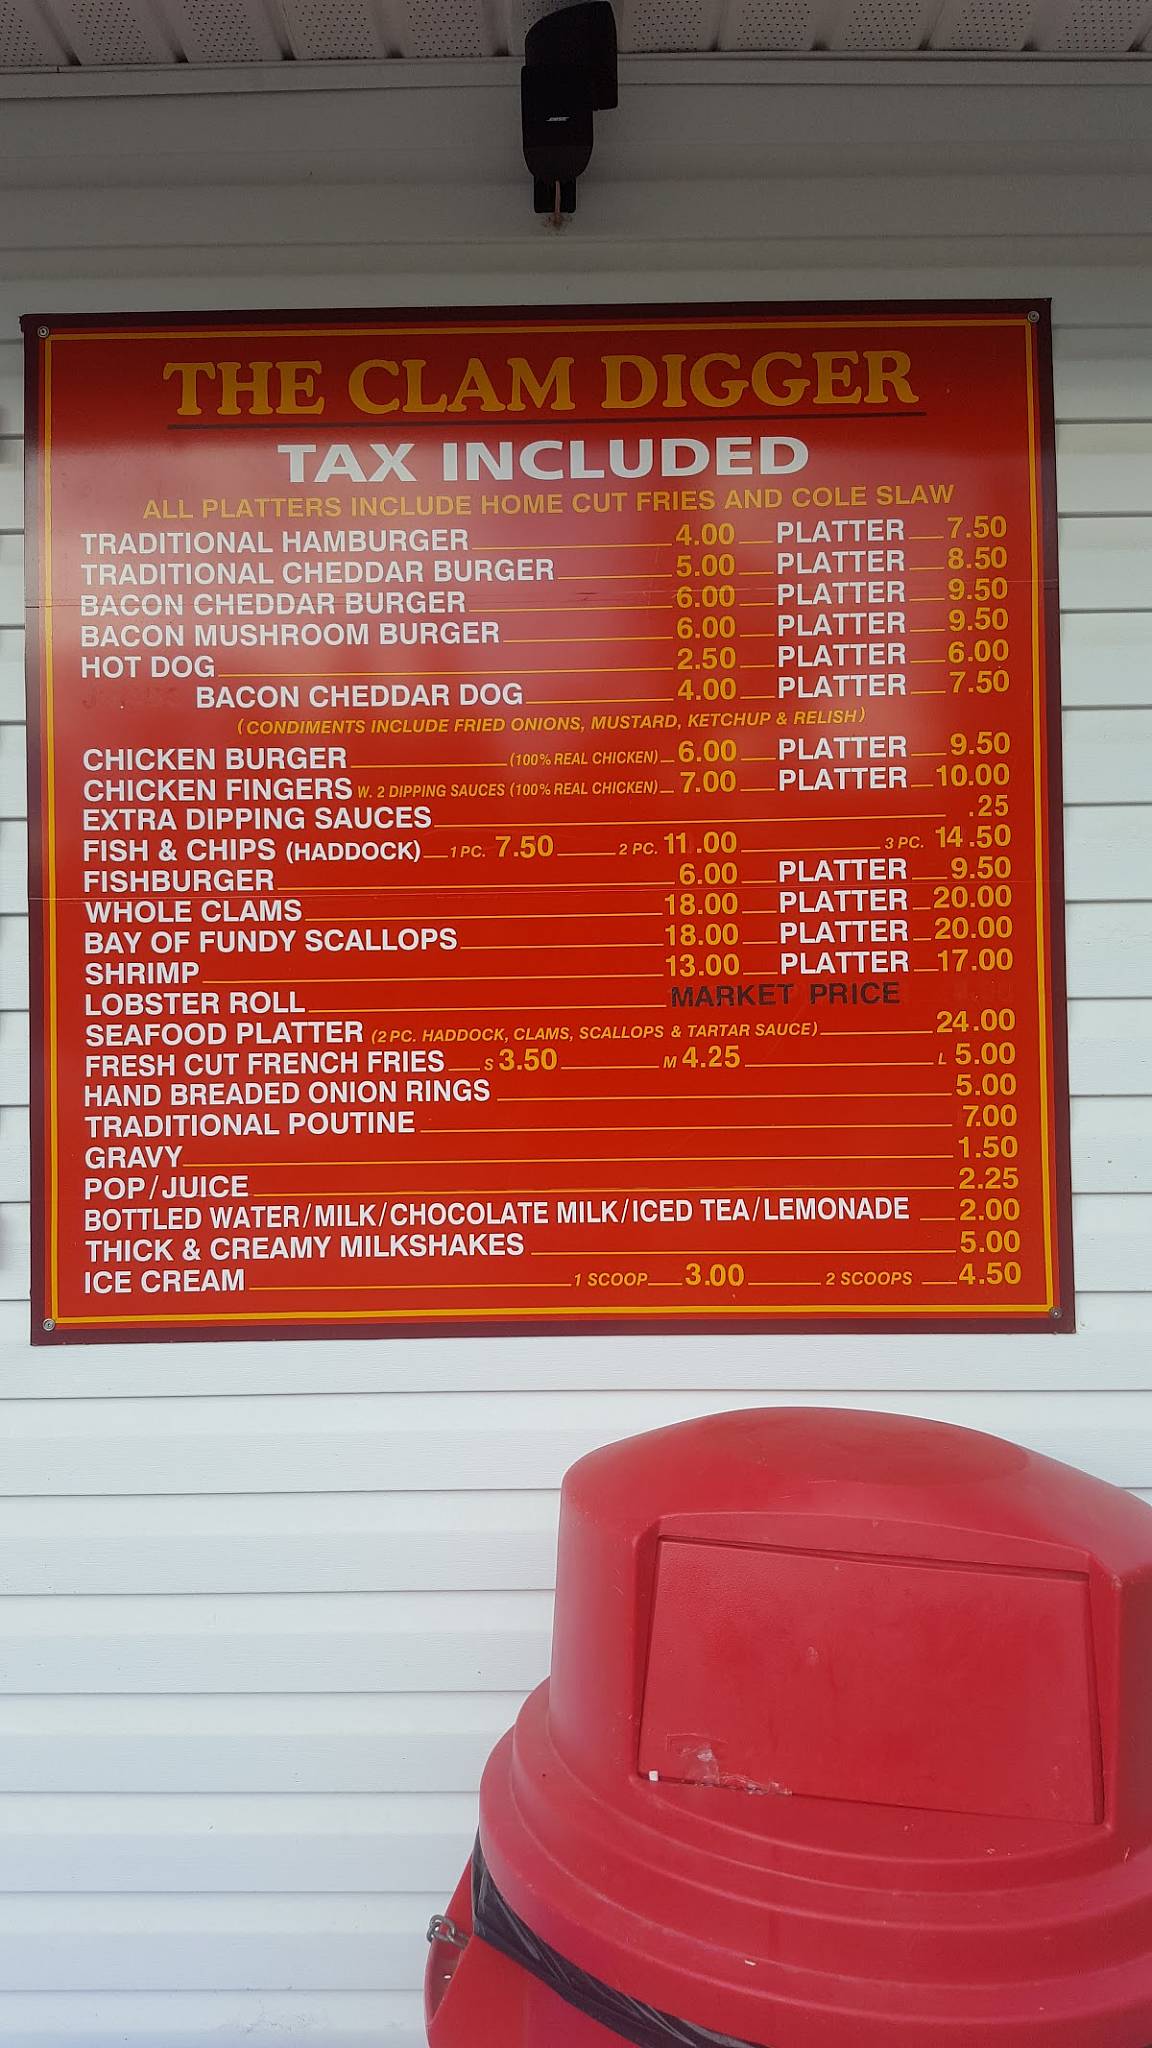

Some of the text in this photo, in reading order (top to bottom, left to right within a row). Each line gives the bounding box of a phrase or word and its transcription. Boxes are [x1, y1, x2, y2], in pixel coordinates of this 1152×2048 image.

[163, 351, 919, 415] THE CLAM DIGGER
[278, 437, 808, 482] TAX INCLUDED
[143, 485, 953, 519] ALL PLATTERS INCLUDE HOME CUT FRIES AND COLE SLAW
[676, 522, 734, 545] 4.00
[778, 519, 904, 543] PLATTER
[947, 516, 1006, 539] 7.50
[81, 529, 468, 554] TRADITIONAL HAMBURGER
[677, 554, 734, 577] 5.00
[778, 550, 904, 574] PLATTER
[948, 546, 1007, 569] 8.50
[81, 559, 553, 585] TRADITIONAL CHEDDAR BURGER
[676, 584, 735, 608] 6.00
[778, 581, 905, 605] PLATTER
[948, 577, 1007, 601] 9.50
[81, 591, 466, 616] BACON CHEDDAR BURGER
[677, 616, 735, 639] 6.00
[779, 612, 905, 636] PLATTER
[949, 607, 1008, 631] 9.50
[81, 622, 499, 647] BACON MUSHROOM BURGER
[678, 647, 735, 669] 2.50
[779, 643, 905, 667] PLATTER
[949, 639, 1008, 663] 6.00
[82, 656, 214, 678] HOT DOG
[678, 678, 736, 700] 4.00
[779, 674, 905, 698] PLATTER
[950, 670, 1009, 693] 7.50
[197, 683, 522, 708] BACON CHEDDAR DOG
[238, 707, 865, 734] (CONDIMENTS INCLUDE FRIED ONIONS, MUSTARD, KETCHUP & RELISH)
[679, 740, 736, 762] 6.00
[780, 736, 906, 760] PLATTER
[951, 732, 1010, 755] 9.50
[83, 747, 346, 771] CHICKEN BURGER
[510, 750, 658, 767] (100% REAL CHICKEN)
[681, 770, 736, 793] 7.00
[780, 767, 906, 791] PLATTER
[936, 763, 1009, 786] 10.00
[84, 778, 352, 801] CHICKEN FINGERS
[84, 806, 431, 830] EXTRA DIPPING SAUCES
[968, 795, 1009, 818] .25
[496, 835, 553, 858] 7.50
[664, 832, 736, 854] 11.00
[936, 824, 1011, 848] 14.50
[84, 838, 420, 863] FISH & CHIPS (HADDOCK)
[680, 863, 737, 885] 6.00
[780, 858, 906, 882] PLATTER
[951, 856, 1011, 879] 9.50
[84, 869, 273, 892] FISHBURGER
[665, 893, 737, 915] 18.00
[780, 889, 907, 913] PLATTER
[934, 885, 1011, 908] 20.00
[85, 899, 301, 923] WHOLE CLAMS
[665, 923, 738, 945] 18.00
[781, 920, 908, 943] PLATTER
[935, 916, 1012, 939] 20.00
[85, 928, 457, 953] BAY OF FUNDY SCALLOPS
[666, 954, 739, 977] 13.00
[782, 951, 908, 974] PLATTER
[938, 948, 1013, 971] 17.00
[86, 962, 199, 985] SHRIMP
[86, 992, 305, 1015] LOBSTER ROLL
[672, 982, 900, 1007] MARKET PRICE
[937, 1009, 1015, 1032] 24.00
[86, 1021, 362, 1046] SEAFOOD PLATTER
[372, 1022, 817, 1044] (2 PC. HADDOCK, CLAMS, SCALLOPS & TARTAR SAUCE)
[86, 1050, 444, 1077] FRESH CUT FRENCH FRIES
[499, 1048, 557, 1071] 3.50
[682, 1045, 740, 1068] 4.25
[956, 1042, 1015, 1064] 5.00
[85, 1079, 489, 1106] HAND BREADED ONION RINGS
[956, 1073, 1016, 1096] 5.00
[85, 1111, 414, 1137] TRADITIONAL POUTINE
[963, 1104, 1017, 1127] 7.00
[85, 1146, 182, 1169] GRAVY
[959, 1136, 1017, 1158] 1.50
[959, 1167, 1018, 1189] 2.25
[85, 1208, 201, 1231] BOTTLED
[960, 1198, 1019, 1220] 2.00
[85, 1233, 523, 1262] THICK & CREAMY MILKSHAKES
[961, 1230, 1020, 1253] 5.00
[85, 1269, 244, 1293] ICE CREAM
[686, 1263, 744, 1286] 3.00
[826, 1272, 912, 1285] 2 SCOOPS
[959, 1262, 1021, 1284] 4.50
